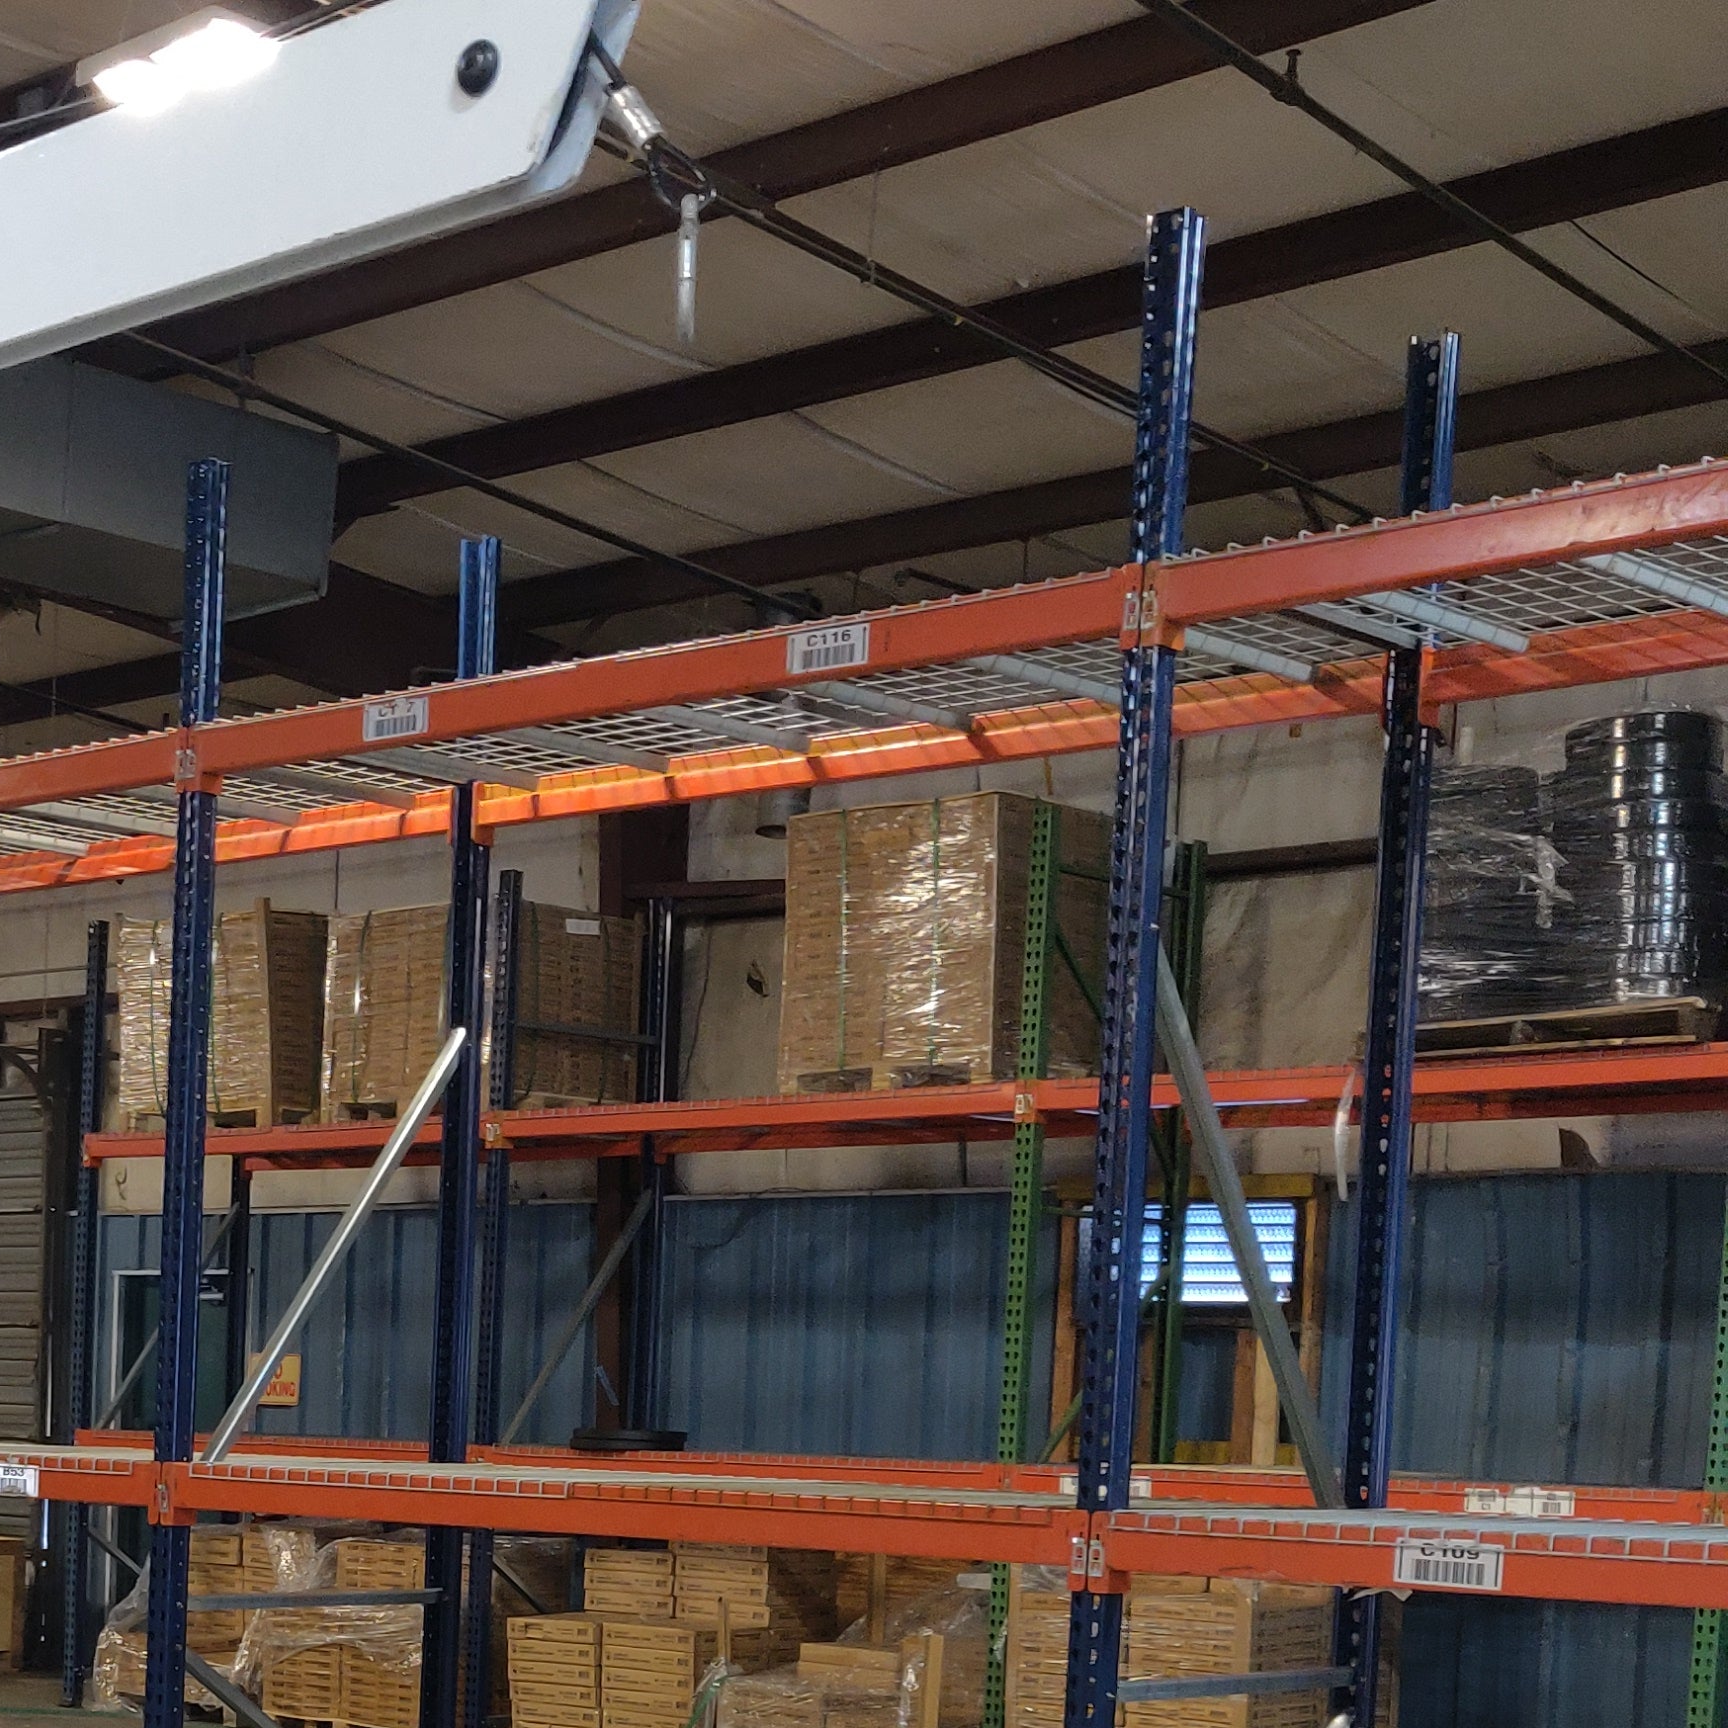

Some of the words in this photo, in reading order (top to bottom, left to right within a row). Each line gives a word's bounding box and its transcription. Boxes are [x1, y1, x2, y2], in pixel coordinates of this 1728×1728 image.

[807, 629, 851, 648] C116
[3, 1467, 24, 1477] B53
[1420, 1543, 1480, 1560] C109
